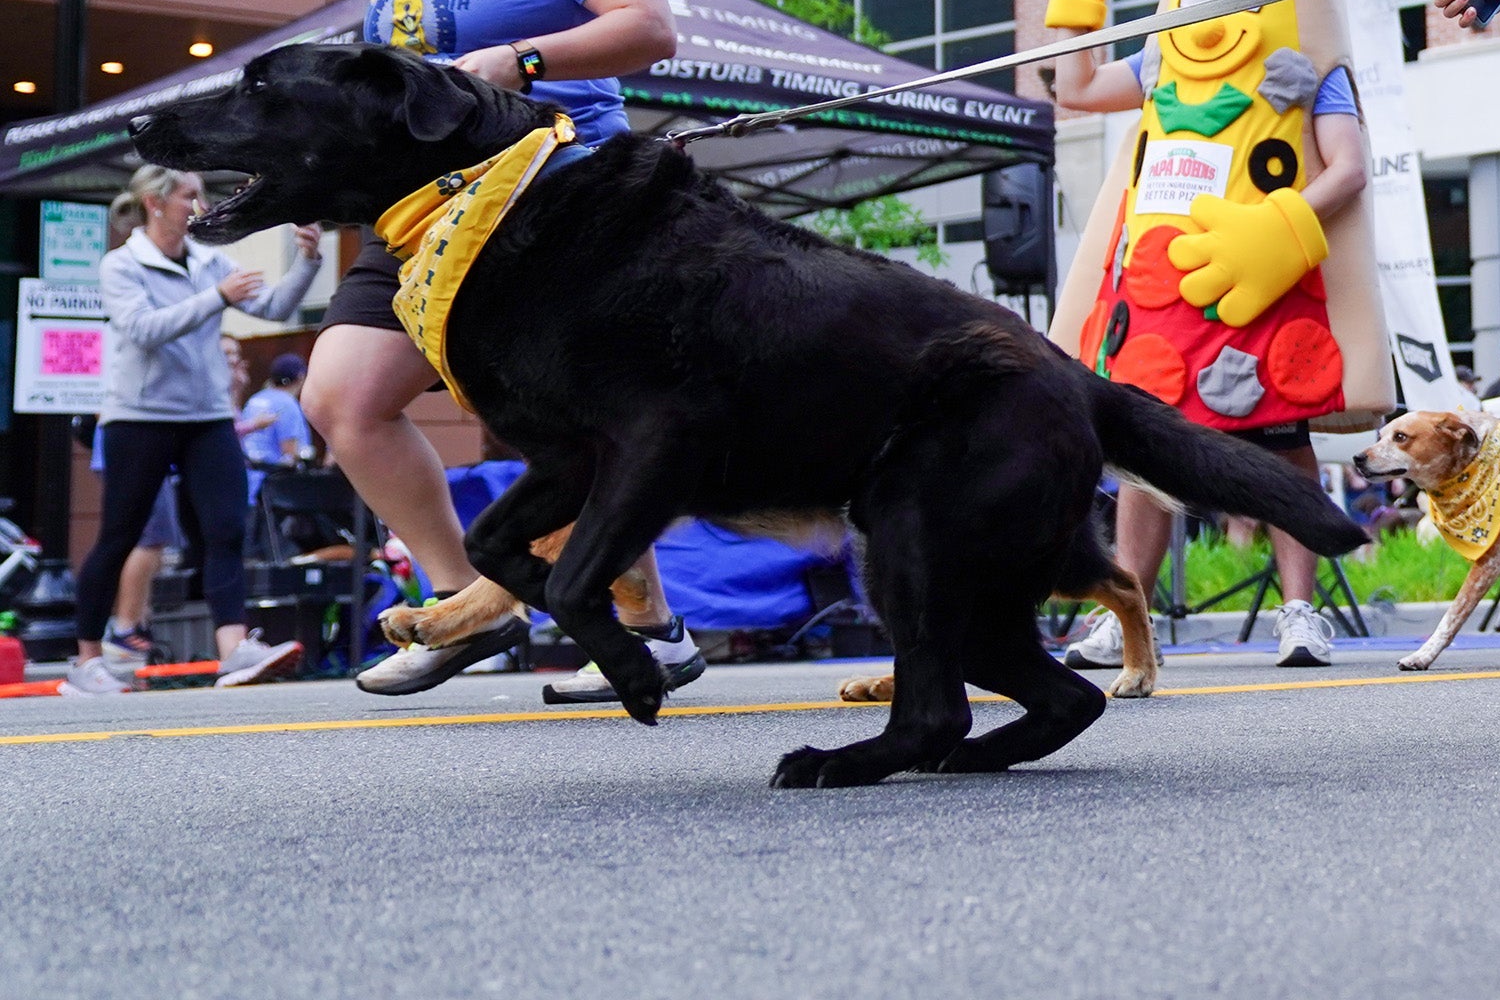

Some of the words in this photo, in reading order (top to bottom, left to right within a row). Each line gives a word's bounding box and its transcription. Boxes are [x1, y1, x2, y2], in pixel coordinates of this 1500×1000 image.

[651, 58, 762, 84] DISTURB
[770, 68, 861, 98] TIMING
[867, 84, 958, 115] DURING
[963, 100, 1037, 126] EVENT
[1148, 158, 1174, 178] PAPA
[1174, 157, 1216, 181] JOHNS
[1178, 191, 1196, 201] PIZ
[25, 296, 45, 308] NO
[51, 297, 103, 310] PARKIN
